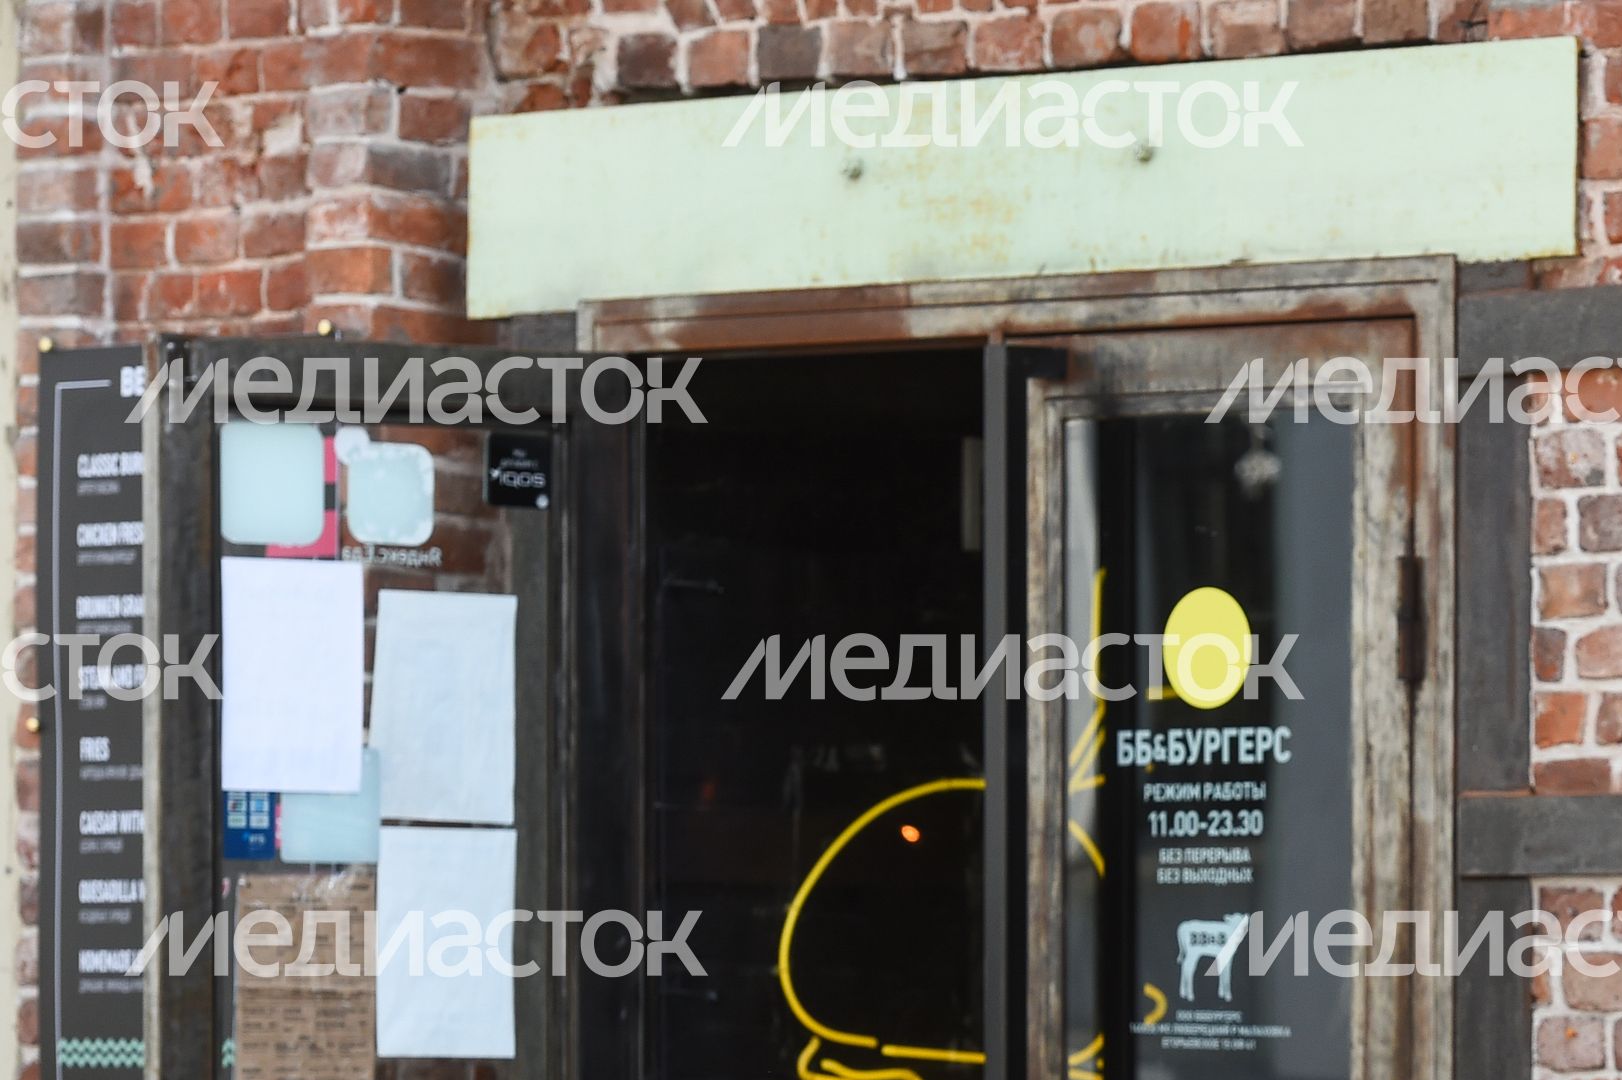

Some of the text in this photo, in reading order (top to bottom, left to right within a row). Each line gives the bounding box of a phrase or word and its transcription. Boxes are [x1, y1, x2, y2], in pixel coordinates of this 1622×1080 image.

[1116, 726, 1293, 766] ББ&БУРГЕРС
[1143, 781, 1267, 802] РЕЖИМ РАБОТЫ
[1147, 809, 1264, 838] 11.00-23.30
[1158, 847, 1251, 865] БЕЗ ПЕРЕРЫВА
[1156, 867, 1254, 886] БЕЗ ВЫХОДНЫХ
